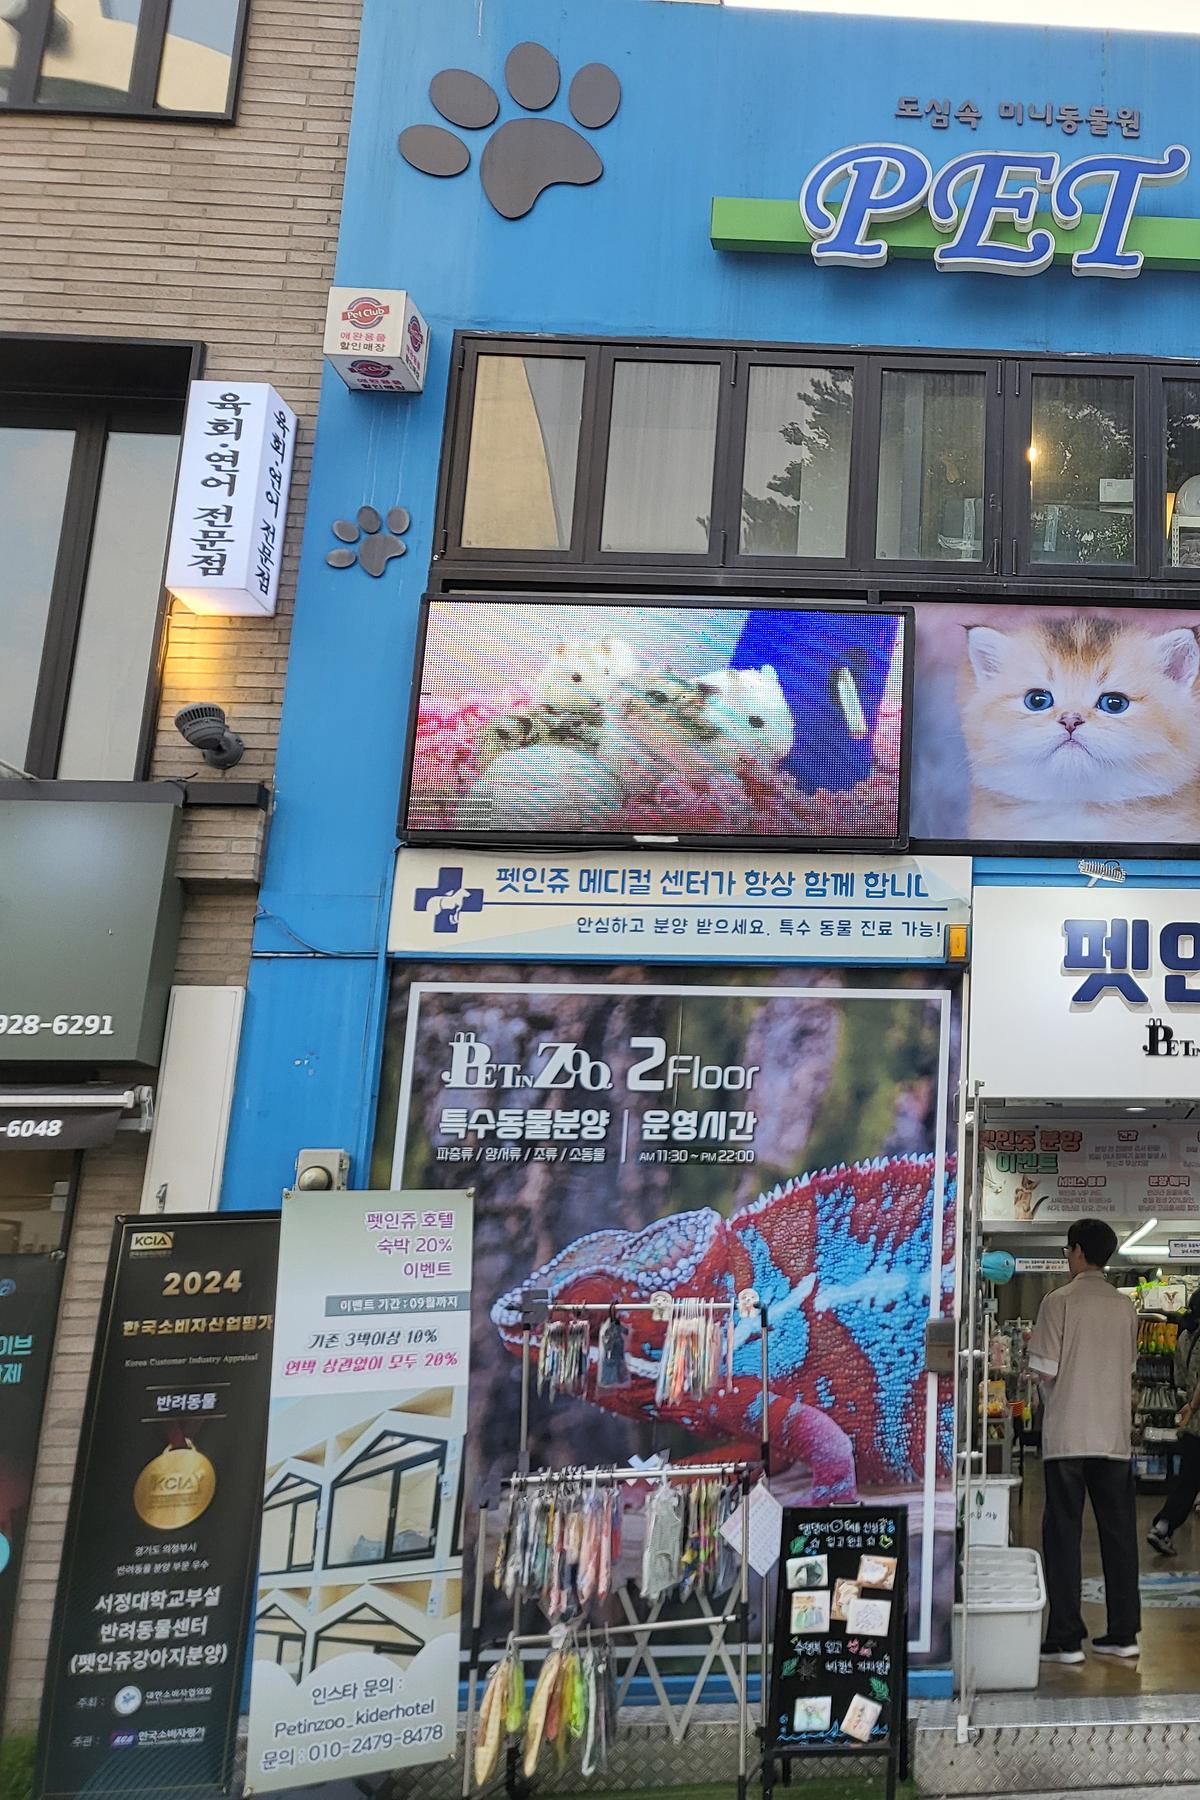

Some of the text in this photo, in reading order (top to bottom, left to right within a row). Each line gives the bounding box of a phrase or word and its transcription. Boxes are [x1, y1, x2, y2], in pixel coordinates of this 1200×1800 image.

[895, 96, 1141, 138] 도심속 미니동물원
[801, 143, 1190, 276] PET
[363, 307, 385, 317] Club
[340, 341, 386, 352] 할인매장
[188, 505, 235, 577] 전문점
[496, 867, 570, 894] 펫인쥬
[578, 869, 651, 895] 메디컬
[661, 870, 736, 896] 센터가
[744, 869, 796, 897] 항상
[804, 870, 855, 897] 함께
[577, 917, 941, 937] 안심하고 분양 받으세요. 특수 동물 진료 가능!
[439, 1108, 757, 1142] 특수동물분양 운영시간
[1040, 1130, 1082, 1151] 분양
[436, 1147, 755, 1162] 파충류 양서류 조류 소동물 AM 11:30 PM 22:00
[367, 1212, 454, 1230] 펫인쥬 호텔
[134, 1235, 168, 1247] KCIA
[377, 1238, 452, 1255] 숙박 20%
[404, 1261, 453, 1279] 이벤트
[162, 1269, 243, 1296] 2024
[340, 1298, 374, 1311] 이벤트
[123, 1315, 273, 1336] 한국소비자산업평가
[308, 1333, 339, 1349] 기존
[407, 1329, 438, 1344] 10%
[322, 1355, 383, 1374] 상관없이
[388, 1353, 417, 1369] 모두
[425, 1352, 458, 1367] 20%
[156, 1392, 217, 1411] 반려동물
[94, 1585, 221, 1614] 서정대학교부설
[100, 1616, 208, 1643] 반려동물센터
[70, 1643, 228, 1675] (펫인쥬강아지분양)
[312, 1677, 393, 1705] 인스타 문의
[274, 1699, 434, 1738] Petinzoo_kiderhotel
[262, 1724, 443, 1770] 문의 010-2479-8478
